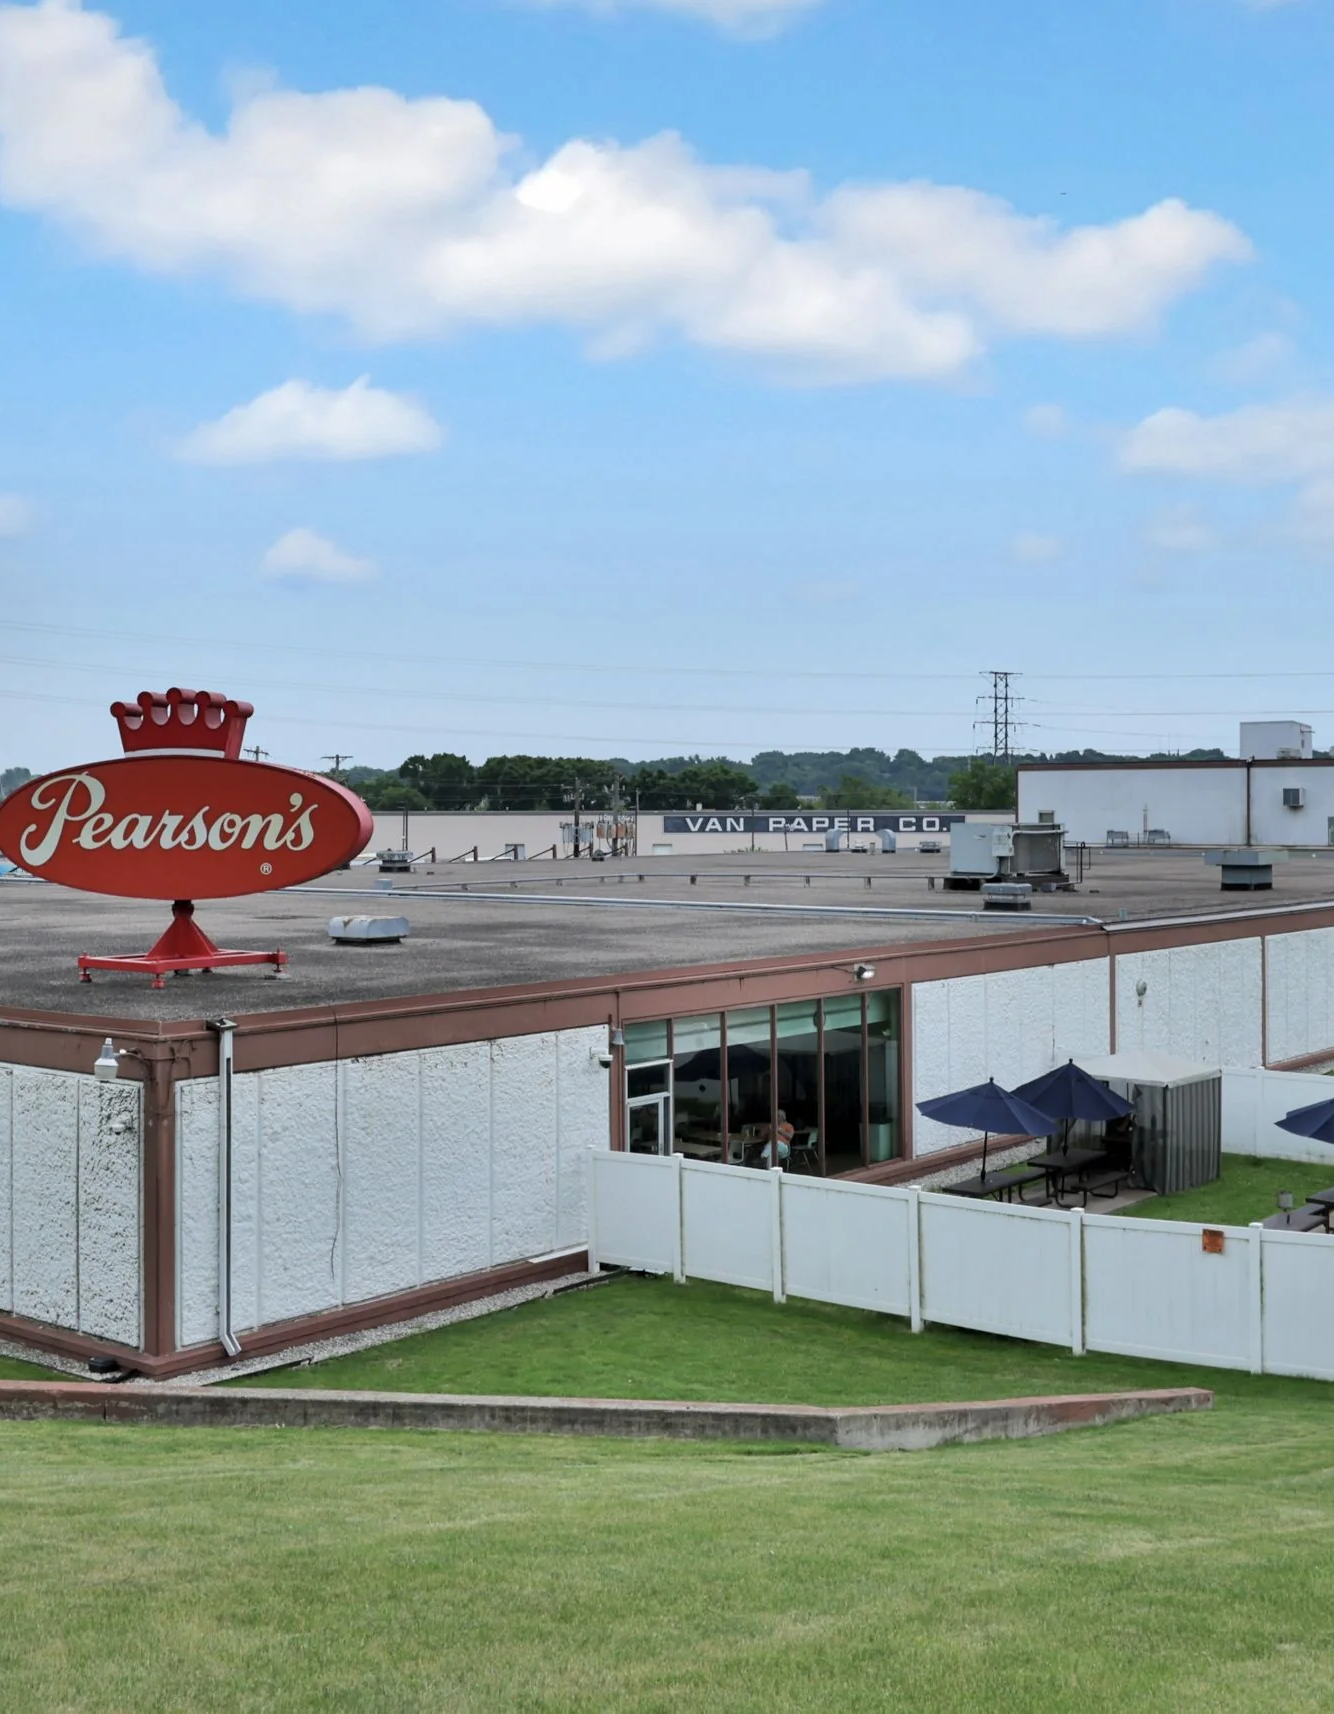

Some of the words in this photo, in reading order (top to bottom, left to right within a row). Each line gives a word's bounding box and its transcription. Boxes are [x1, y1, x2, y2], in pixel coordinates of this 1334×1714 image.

[20, 772, 318, 866] Pearson's
[685, 817, 745, 832] VAN
[768, 817, 875, 832] PAPER
[898, 817, 948, 832] CO.
